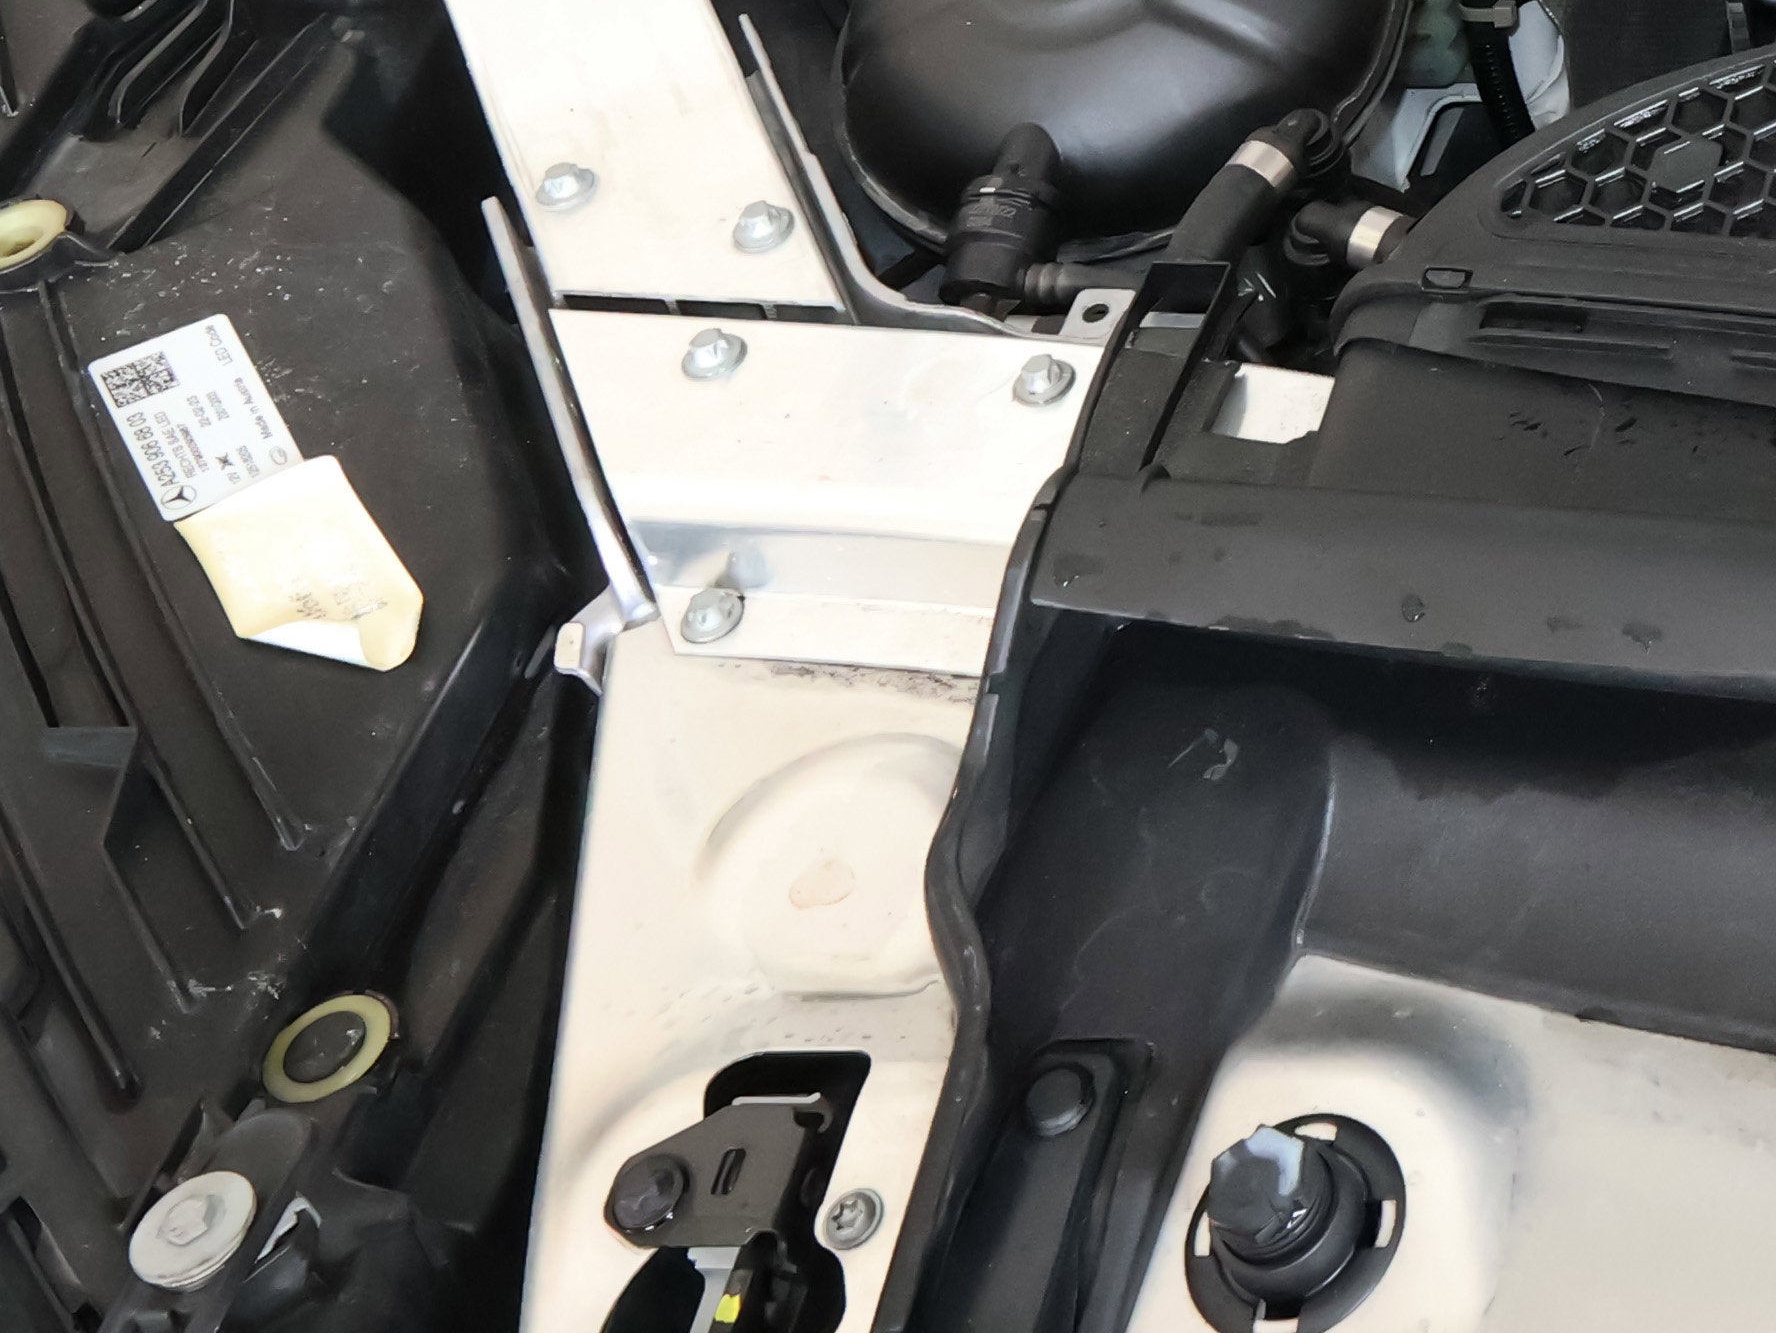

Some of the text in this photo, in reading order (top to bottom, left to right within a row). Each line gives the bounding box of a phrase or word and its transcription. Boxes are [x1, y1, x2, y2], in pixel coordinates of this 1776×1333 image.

[205, 325, 273, 440] Made in Austria LED Code
[126, 412, 179, 487] A253 906 68 03
[154, 412, 197, 478] RECHTS SAE LED
